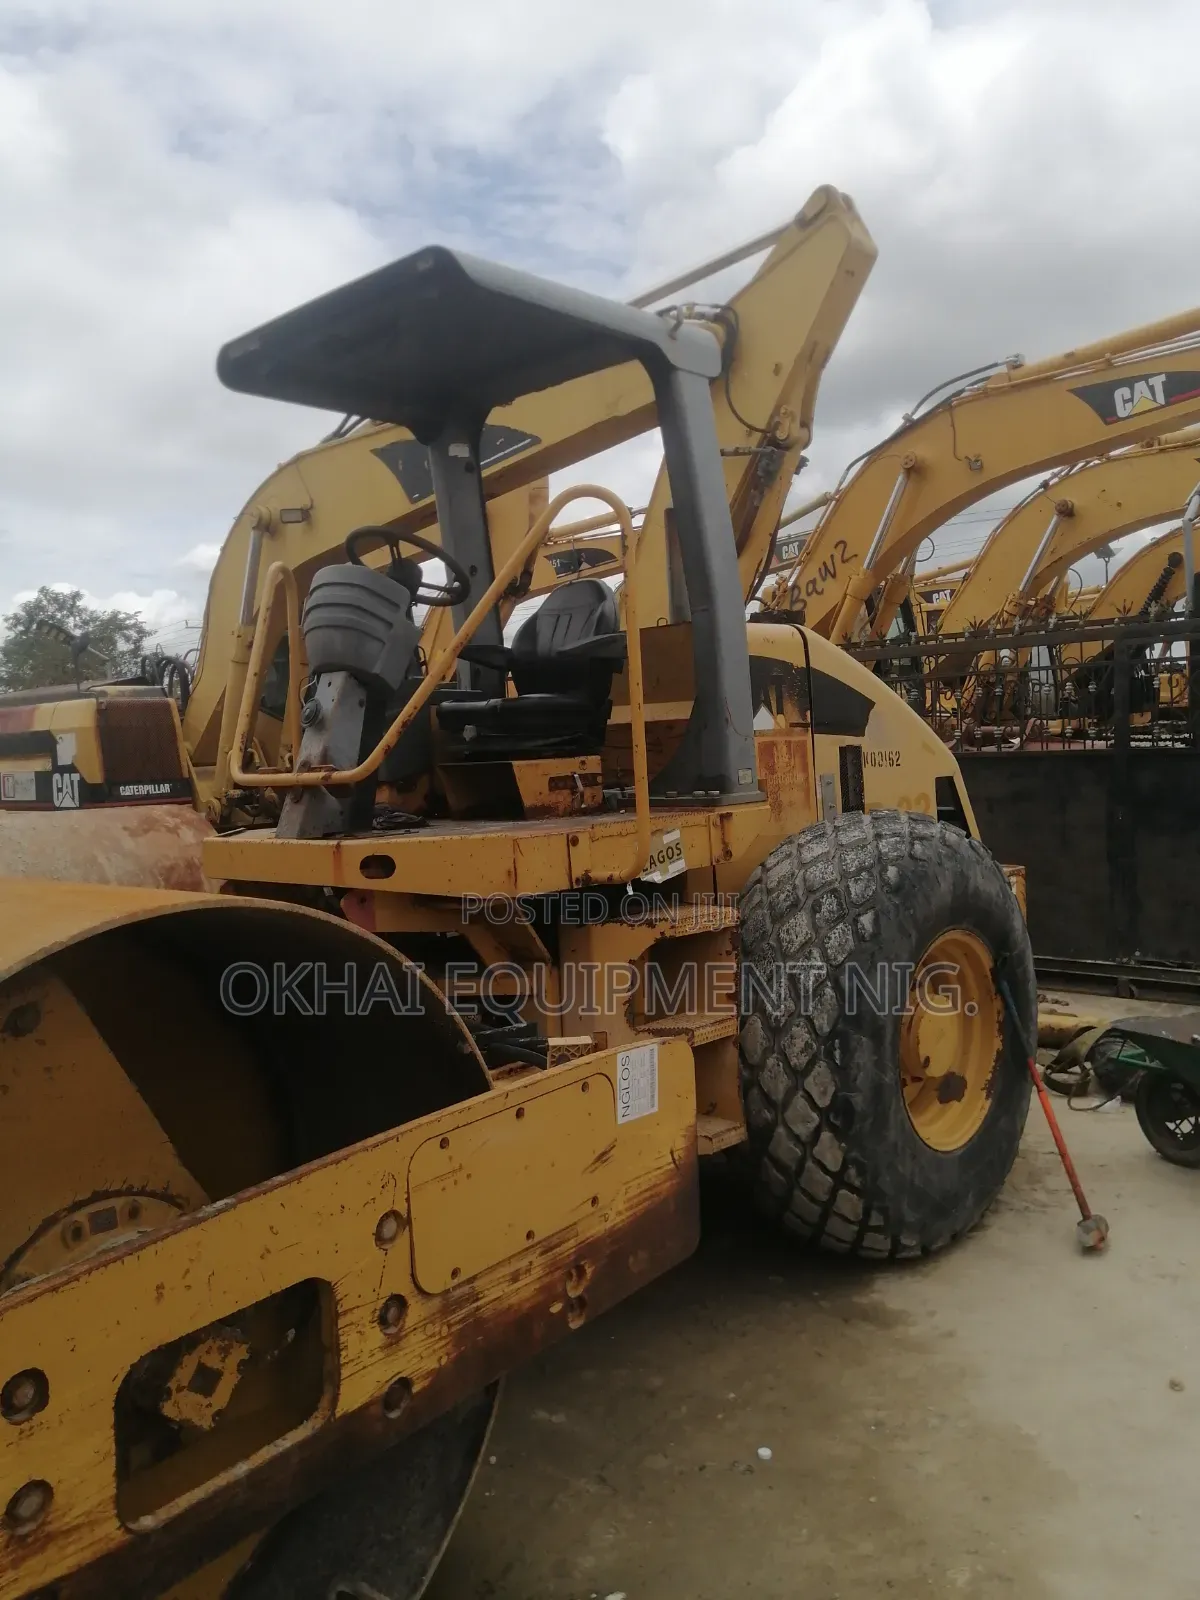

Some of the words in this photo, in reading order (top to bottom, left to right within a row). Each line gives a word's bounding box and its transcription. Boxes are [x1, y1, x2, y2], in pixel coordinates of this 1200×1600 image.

[1114, 373, 1167, 418] CAT
[782, 541, 799, 560] CAT
[932, 589, 951, 604] CAT
[52, 772, 80, 808] CAT
[119, 783, 171, 796] CATERPILLAR
